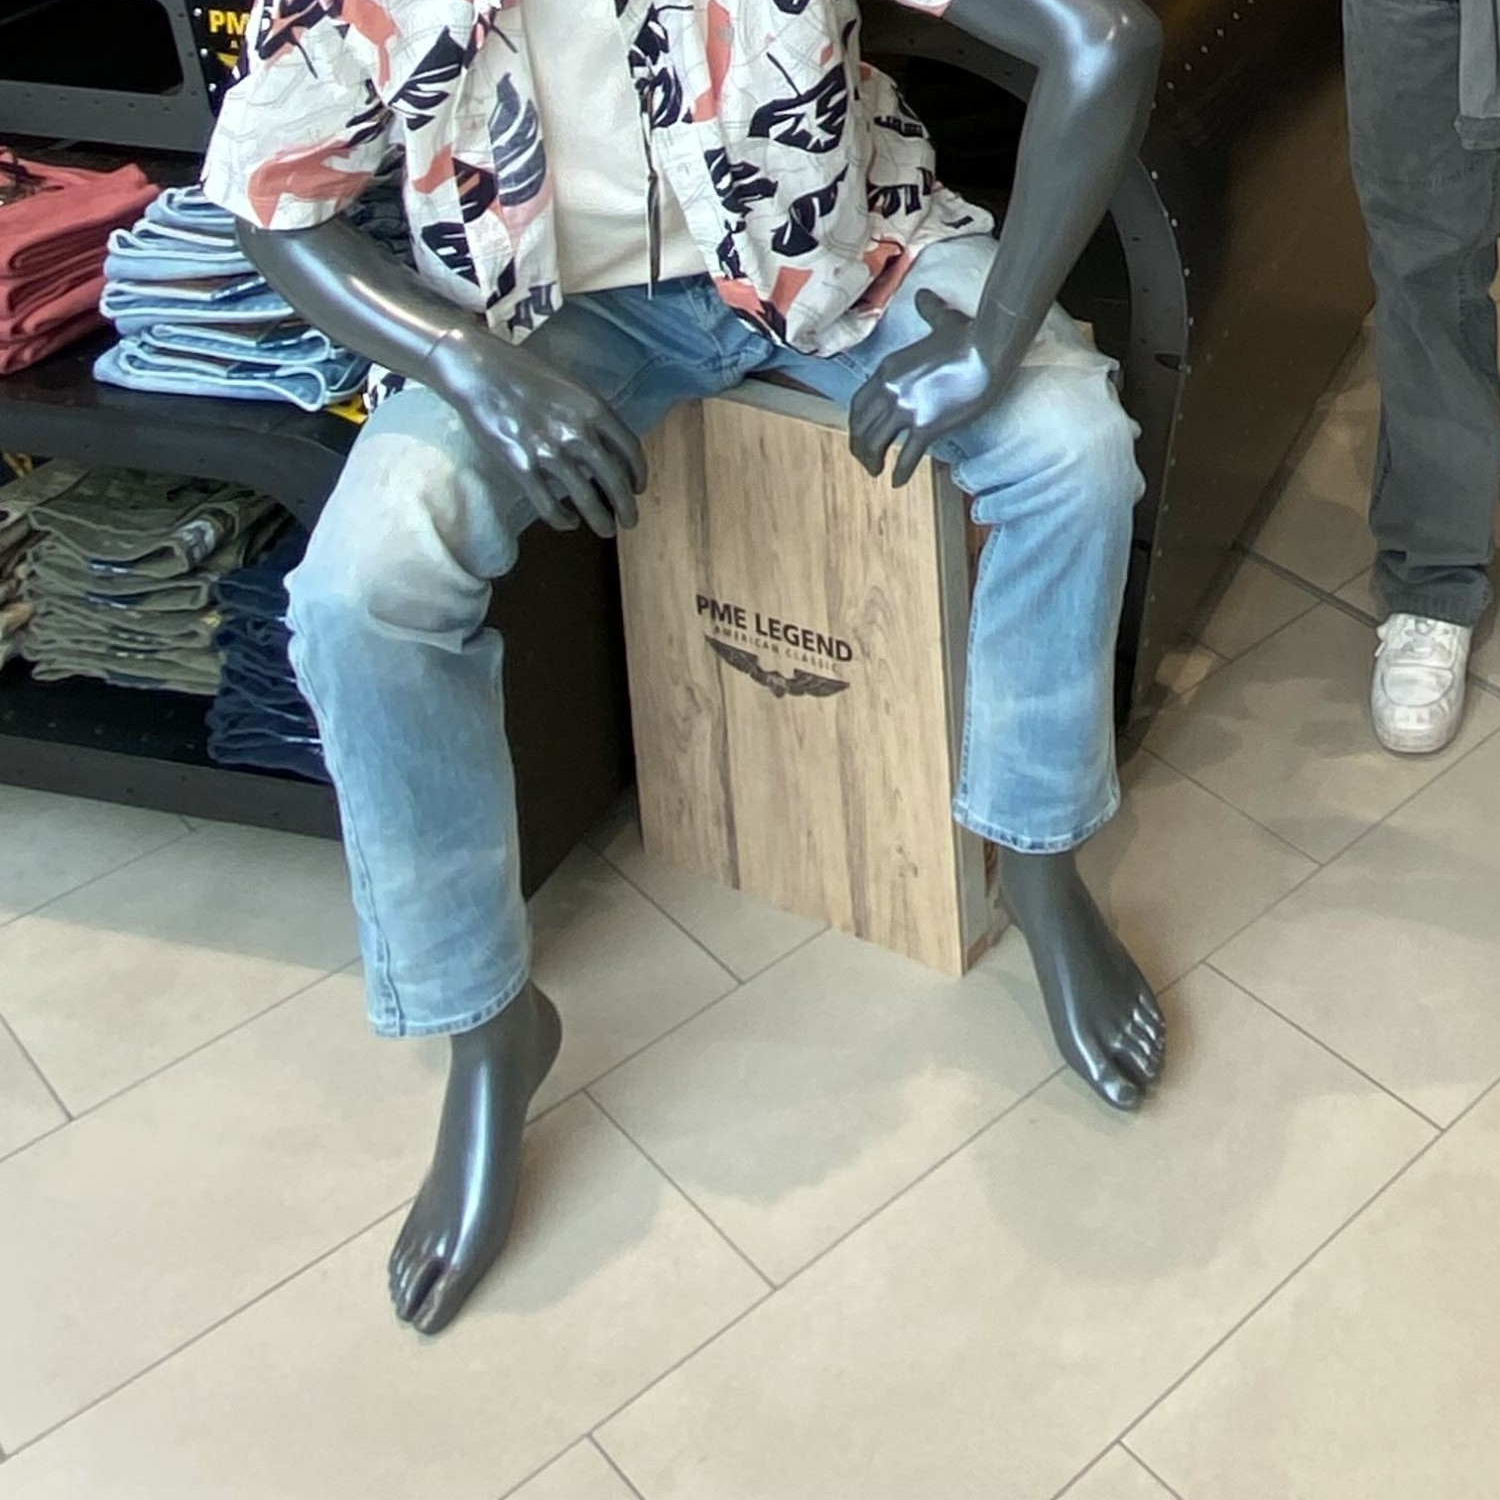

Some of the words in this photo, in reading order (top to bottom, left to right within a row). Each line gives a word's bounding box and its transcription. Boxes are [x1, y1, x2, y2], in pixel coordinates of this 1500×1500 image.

[207, 9, 251, 35] PM
[696, 593, 747, 631] PME
[754, 612, 853, 662] LEGEND
[713, 625, 780, 655] AMERICAN
[785, 649, 839, 673] CLASSIC
